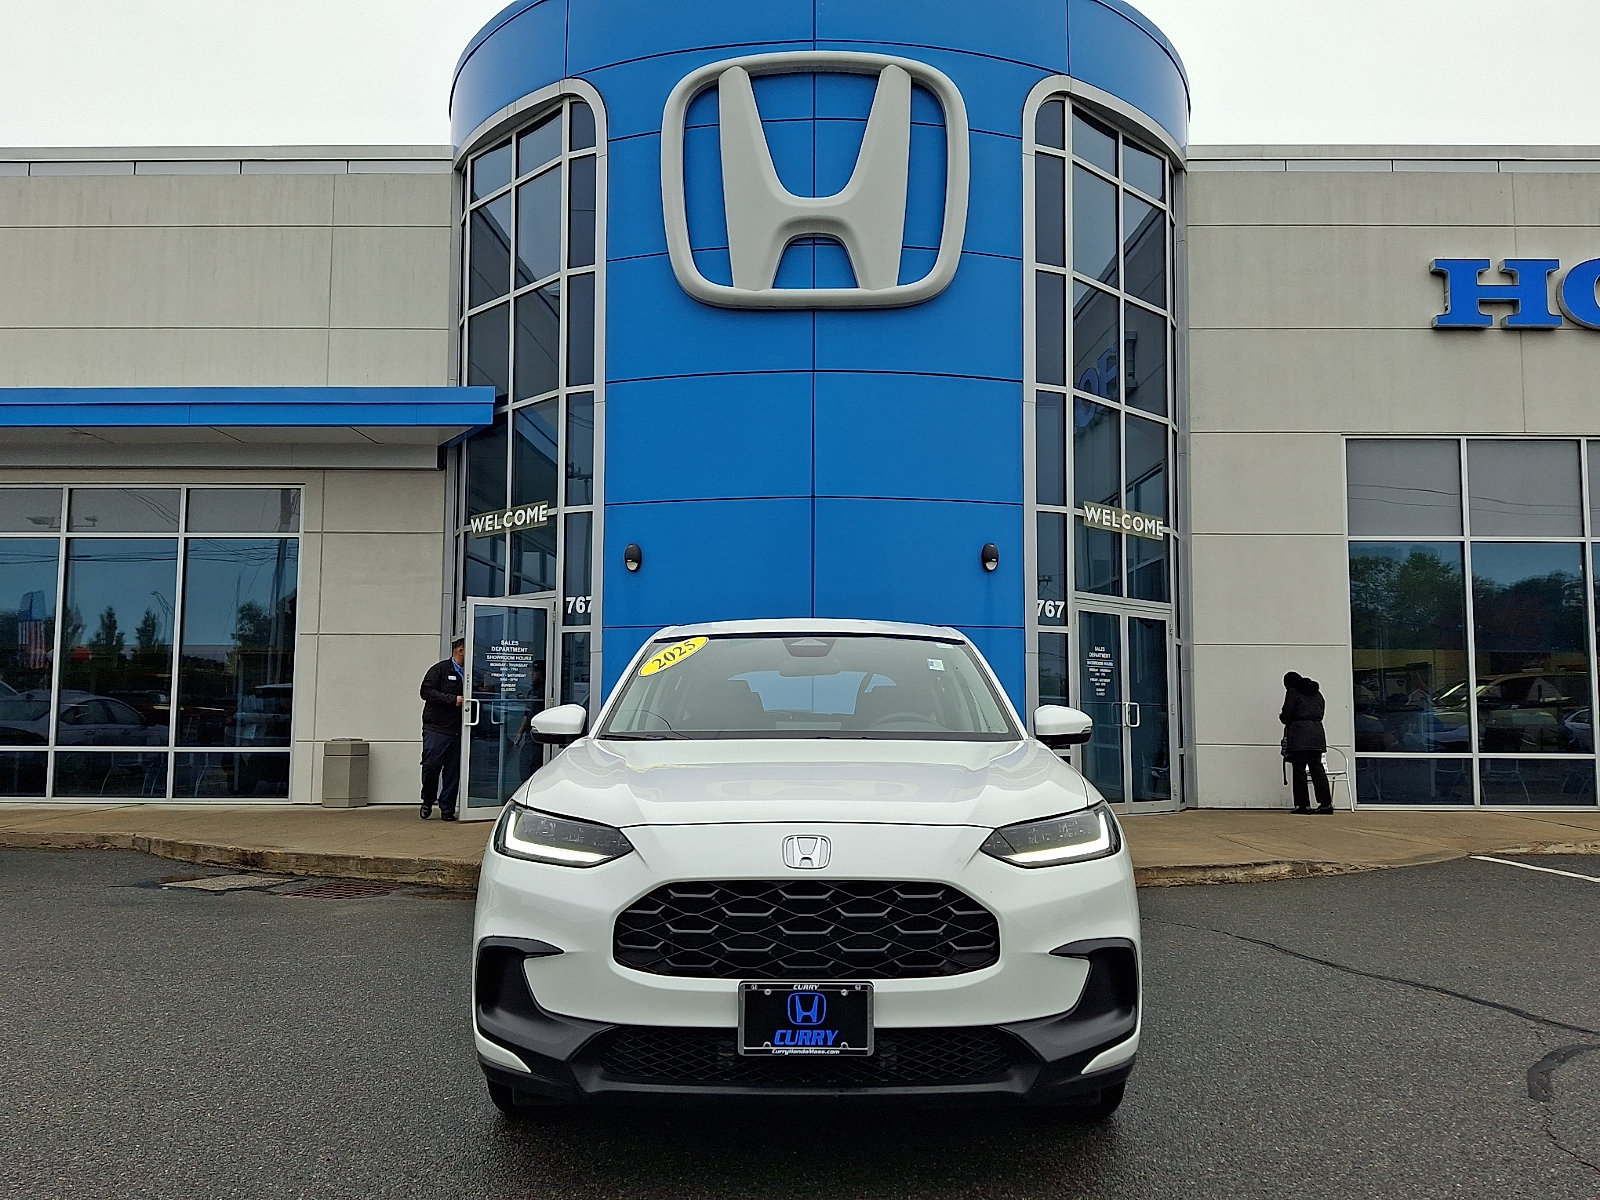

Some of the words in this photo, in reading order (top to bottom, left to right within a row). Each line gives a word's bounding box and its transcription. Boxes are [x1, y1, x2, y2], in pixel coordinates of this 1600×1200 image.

[470, 504, 548, 534] WELCOME
[1084, 505, 1164, 537] WELCOME
[566, 596, 592, 614] 767
[1037, 600, 1065, 619] 767
[652, 641, 695, 669] 2025
[774, 1029, 839, 1046] CURRY
